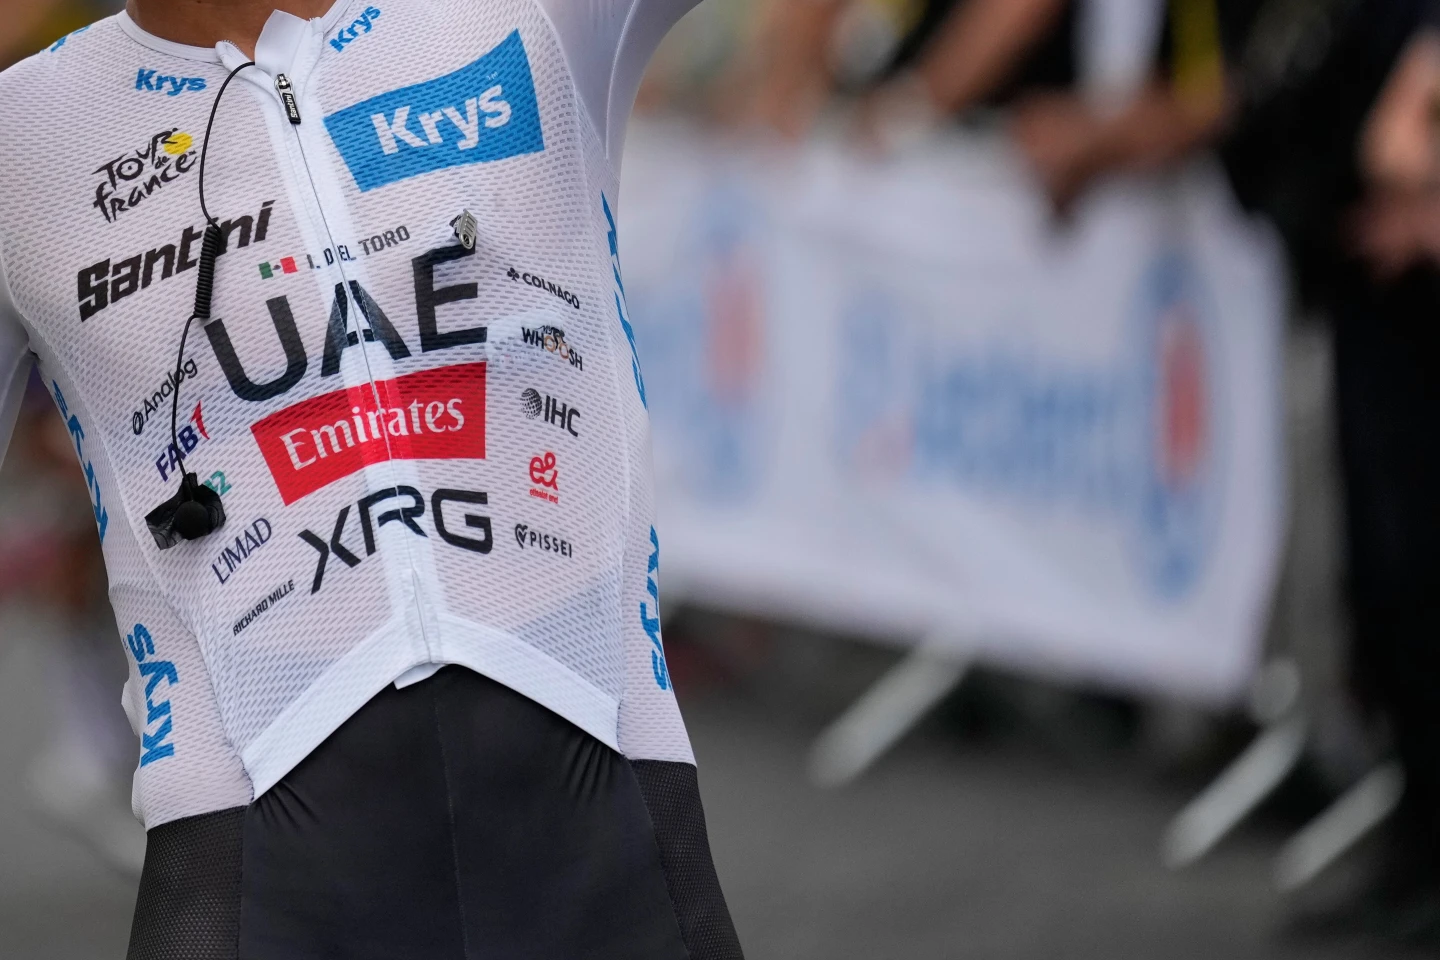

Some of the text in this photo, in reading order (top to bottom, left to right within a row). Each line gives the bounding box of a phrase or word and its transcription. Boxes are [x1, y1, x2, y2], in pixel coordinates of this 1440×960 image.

[329, 6, 381, 53] Krys
[135, 68, 208, 96] Krys
[370, 84, 512, 156] Krys
[77, 200, 276, 322] Santni
[323, 245, 357, 267] DEL
[358, 225, 411, 256] TORO
[204, 237, 488, 402] UAE
[522, 272, 580, 310] COLNAGO
[143, 358, 198, 422] Analog
[544, 394, 581, 437] IHC
[279, 398, 465, 471] Emirates
[211, 517, 272, 585] L'IMAD
[297, 485, 494, 595] XRG
[530, 530, 572, 558] PISSEI
[232, 579, 295, 636] RICHARD MILLE
[127, 623, 179, 769] Krys
